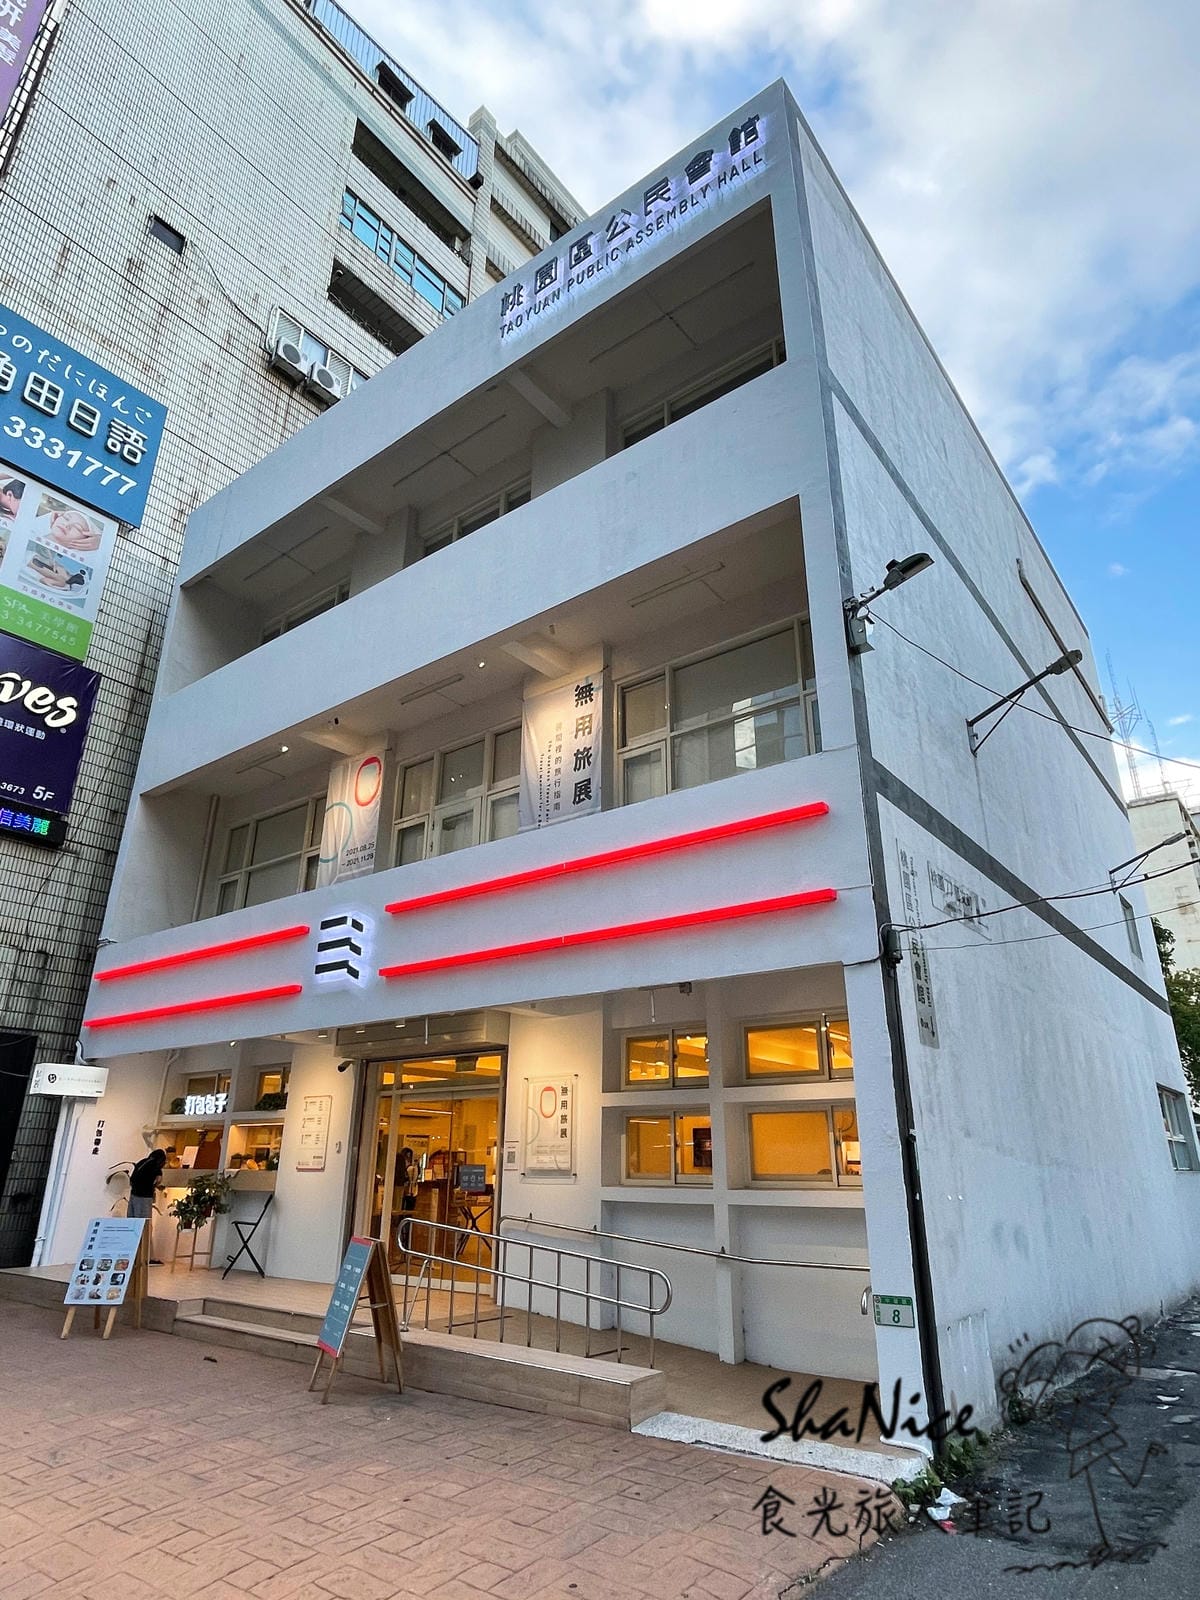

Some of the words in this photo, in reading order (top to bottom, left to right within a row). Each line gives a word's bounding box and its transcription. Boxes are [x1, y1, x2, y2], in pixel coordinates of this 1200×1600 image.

[499, 286, 562, 338] TAOYUAN
[567, 249, 619, 293] PUBLIC
[626, 186, 710, 252] ASSEMBLY
[717, 151, 763, 189] HALL
[500, 114, 760, 317] 桃園區公民會館
[3, 415, 138, 496] 3331777
[32, 785, 56, 802] 5F
[572, 681, 594, 806] 無用旅展
[893, 1309, 901, 1323] 8
